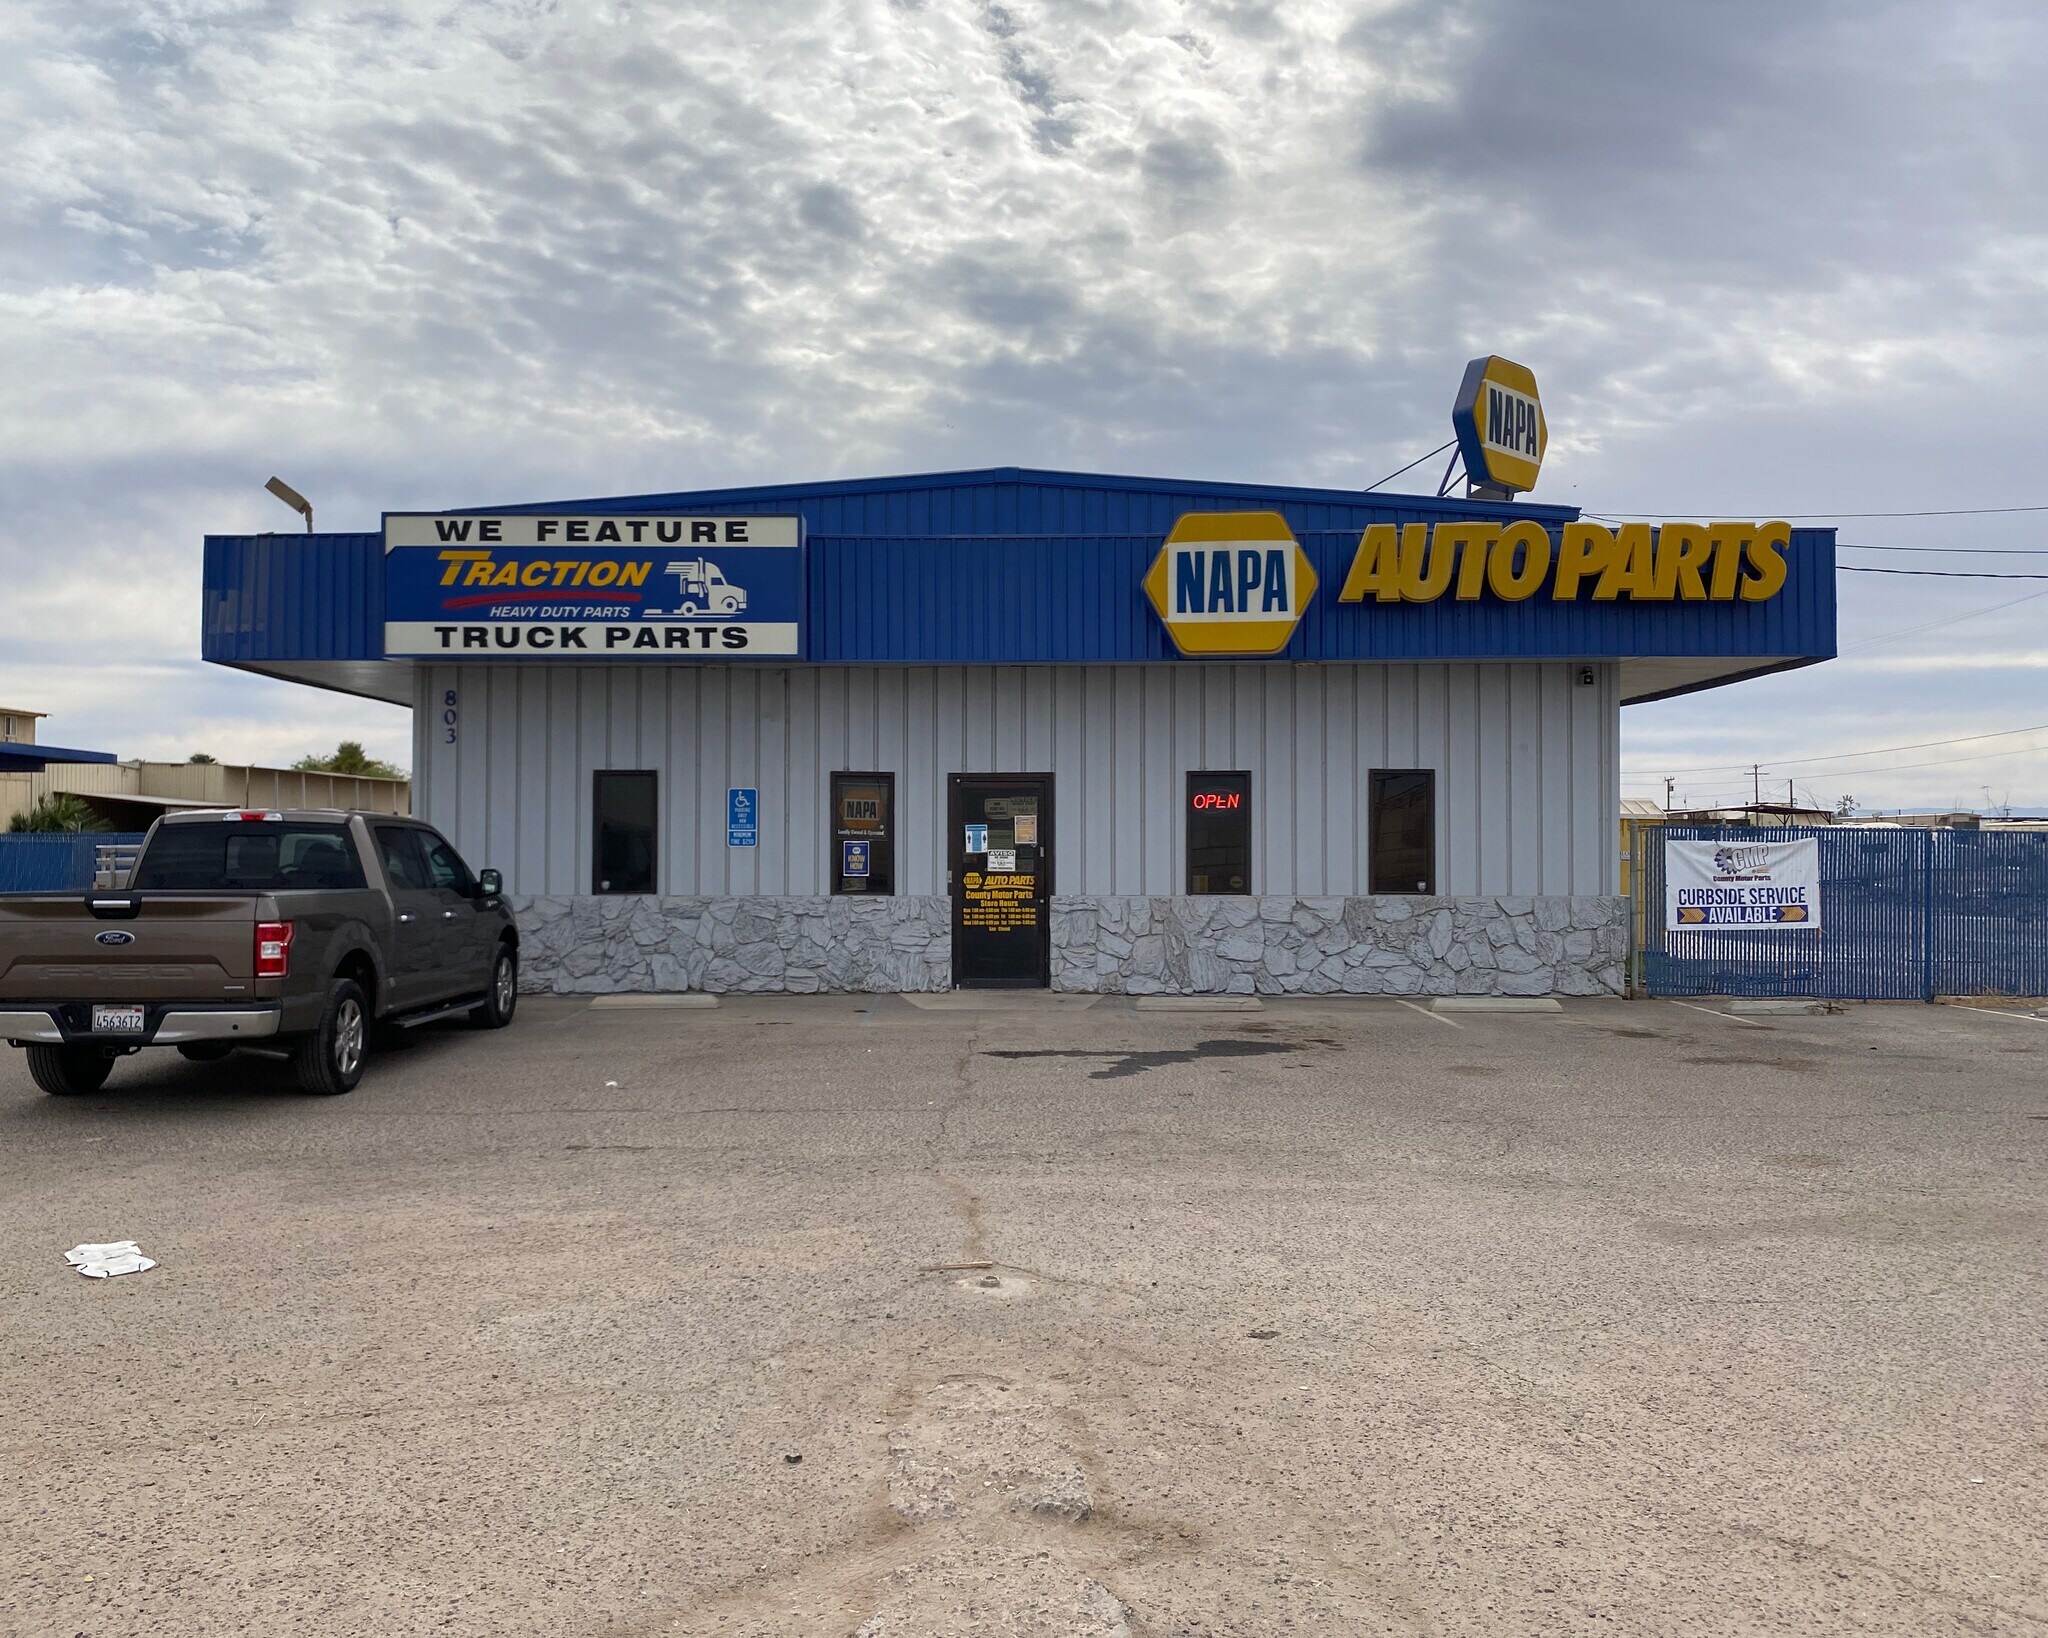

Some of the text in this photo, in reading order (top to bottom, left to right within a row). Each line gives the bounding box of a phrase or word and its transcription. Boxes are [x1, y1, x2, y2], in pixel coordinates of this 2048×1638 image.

[1489, 388, 1538, 457] NAPA
[434, 520, 750, 543] WE FEATURE
[1175, 520, 1792, 615] NAPA AUTO PARTS
[489, 605, 631, 618] HEAVY DUTY PARTS
[434, 625, 749, 649] TRUCK PARTS
[444, 690, 457, 744] 803
[846, 801, 877, 819] NAPA
[1193, 794, 1240, 809] OPEN
[1731, 844, 1769, 871] CMP
[984, 875, 1008, 886] AUTO
[1009, 875, 1035, 886] PARTS
[1713, 875, 1734, 883] County
[1754, 874, 1772, 882] Parts
[965, 890, 1033, 899] County Motor Parts
[1678, 887, 1806, 906] CURBSIDE SERVICE
[1709, 907, 1777, 923] AVAILABLE
[103, 933, 126, 944] Ford
[96, 1015, 141, 1028] 45636T2
